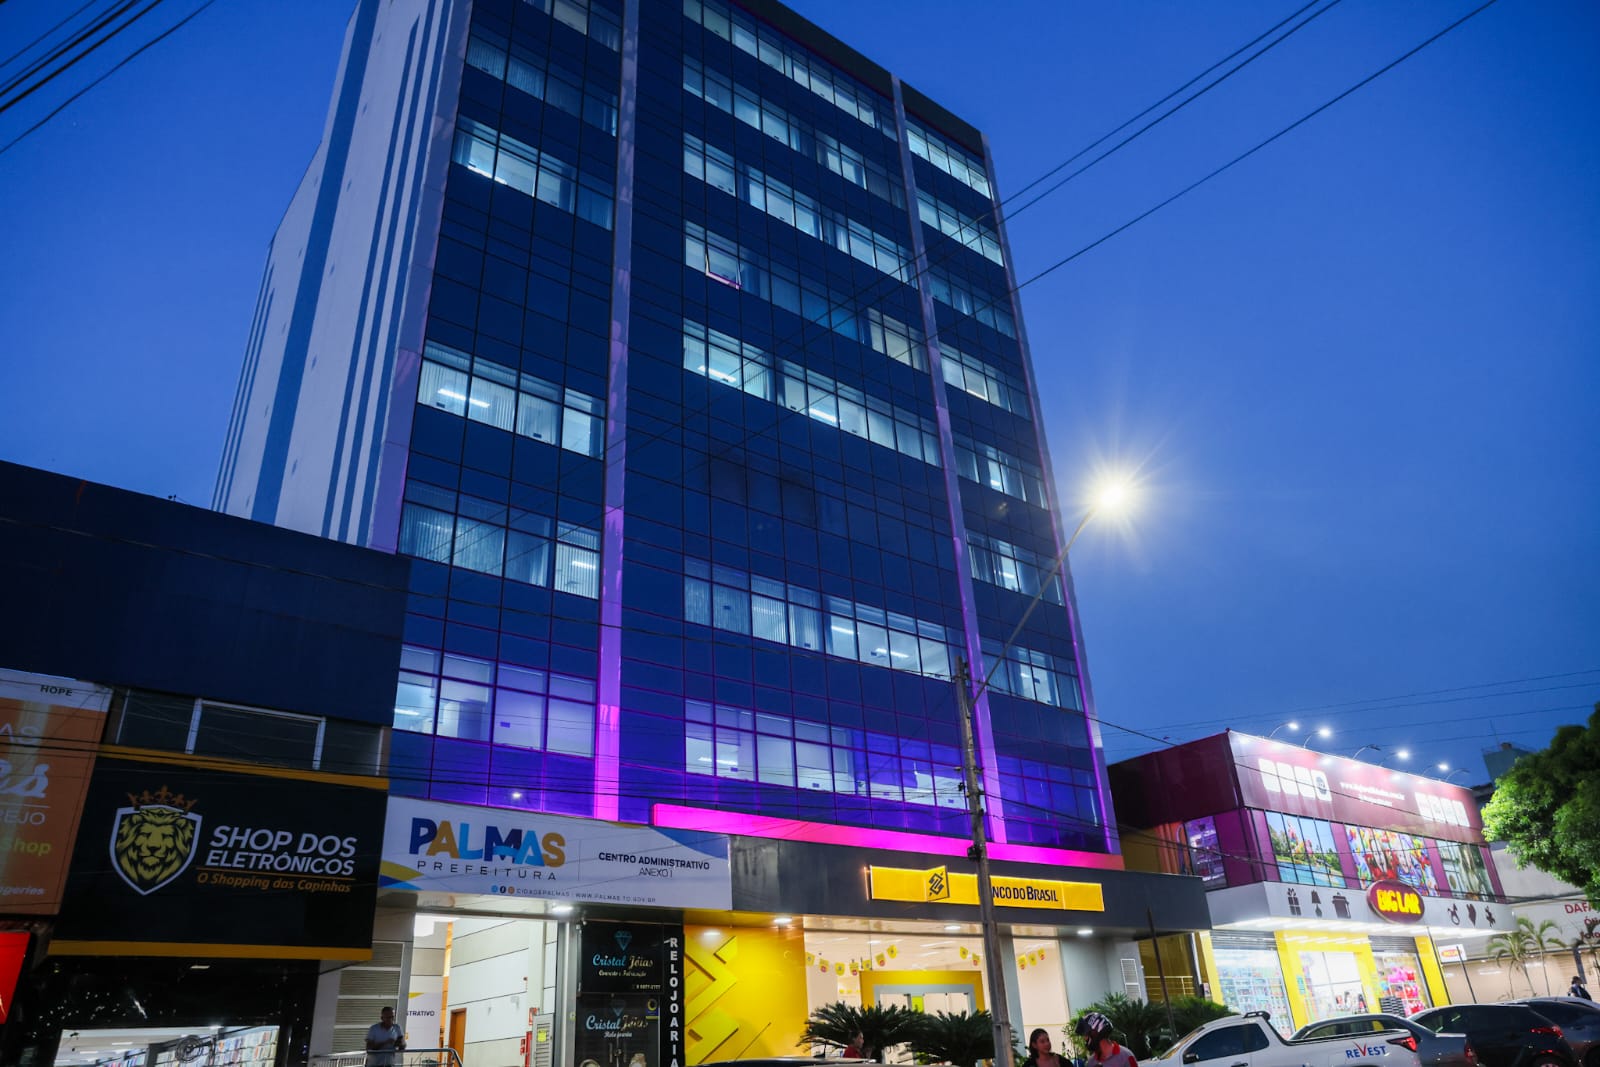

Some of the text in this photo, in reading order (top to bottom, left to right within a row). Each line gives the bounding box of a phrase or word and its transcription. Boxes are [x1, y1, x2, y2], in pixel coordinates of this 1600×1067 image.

[40, 684, 73, 696] HOPE
[0, 809, 46, 825] EJO
[210, 826, 357, 858] SHOP DOS
[409, 817, 566, 868] PALMAS
[205, 850, 355, 876] ELETRÔNICOS
[417, 860, 556, 880] PREFEITURA
[599, 852, 710, 870] CENTRO ADMINISTRATIVO
[638, 868, 669, 877] ANEXO
[197, 873, 352, 893] O Shopping das Capinhas
[1013, 887, 1025, 899] DO
[1026, 886, 1059, 901] BRASIL
[1376, 889, 1421, 915] BIG LAR
[592, 954, 626, 967] Cristal
[669, 937, 679, 1067] RELOJOARIA
[586, 1015, 621, 1029] Cristal
